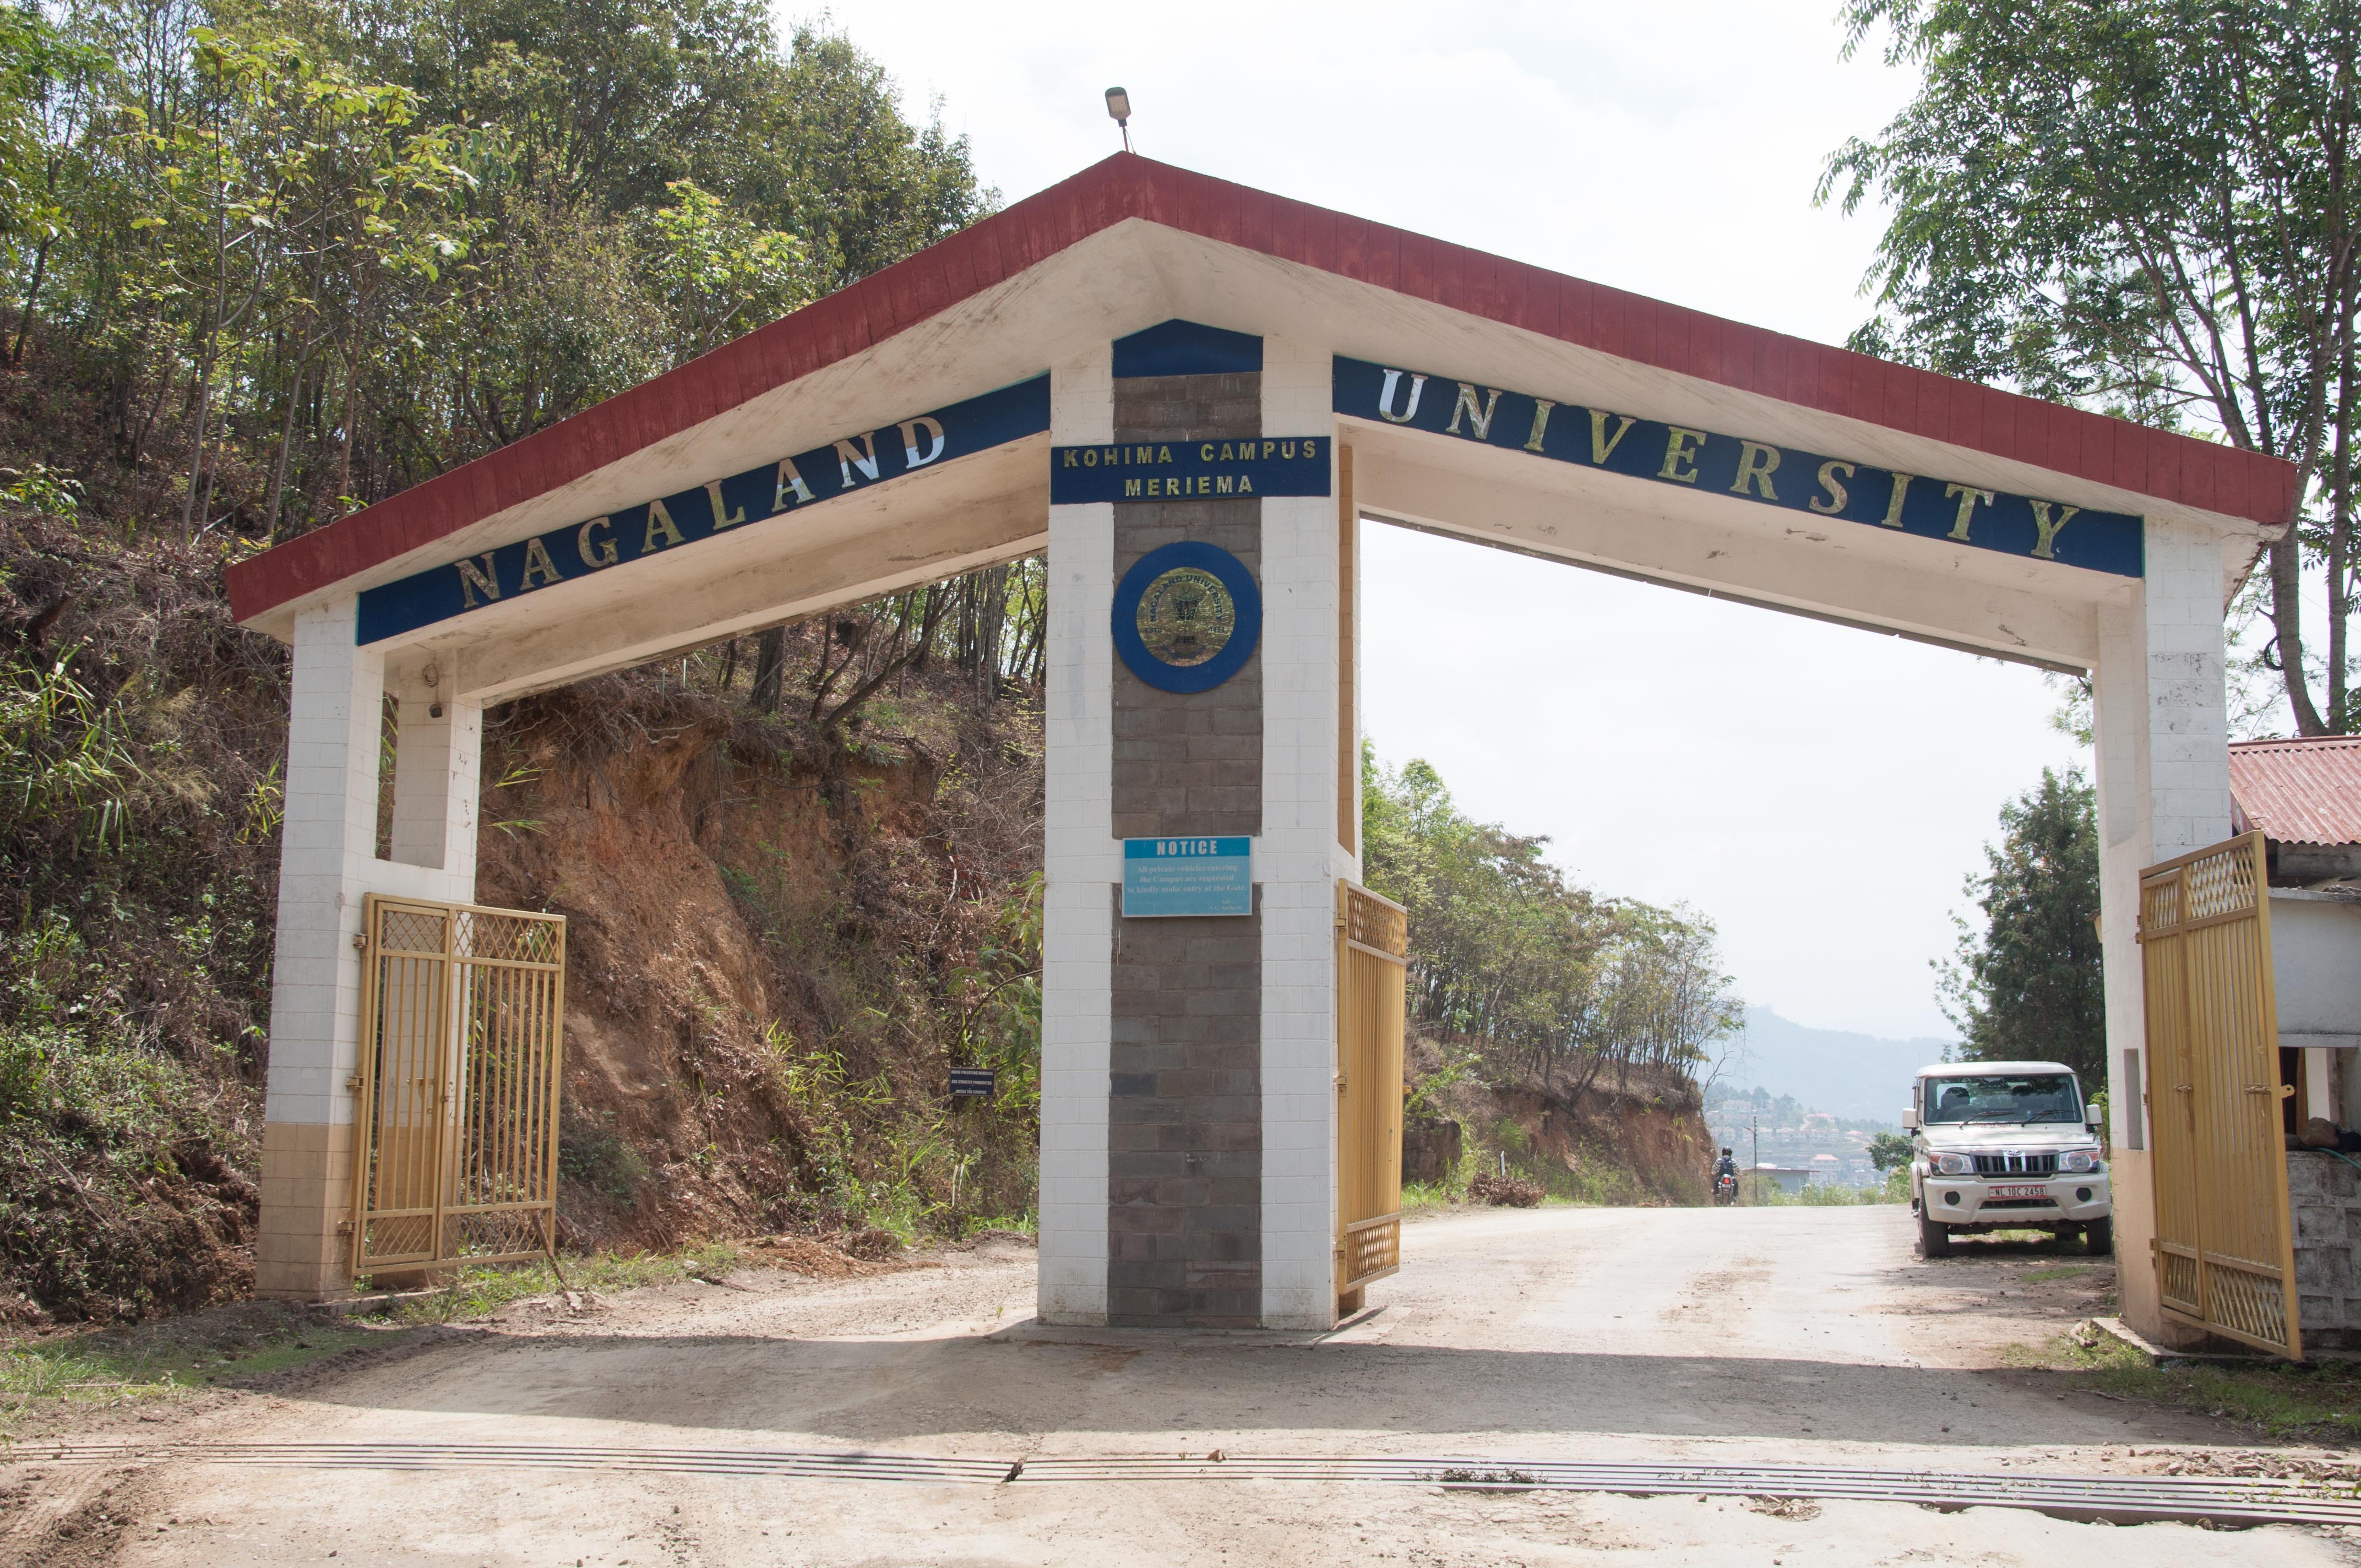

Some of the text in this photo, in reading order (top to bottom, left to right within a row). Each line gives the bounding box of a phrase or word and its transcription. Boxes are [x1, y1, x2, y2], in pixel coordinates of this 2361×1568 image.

[1064, 440, 1316, 467] KOHIMA CAMPUS
[454, 368, 2080, 608] NAGALAND UNIVERSITY
[1125, 475, 1253, 497] MERIEMA
[1150, 574, 1223, 622] NAGALAND UNIVERSITY
[1156, 840, 1217, 856] NOTICE
[1199, 874, 1234, 883] requested
[1136, 886, 1159, 894] kindly
[1995, 1187, 2044, 1196] NL 10C 2458
